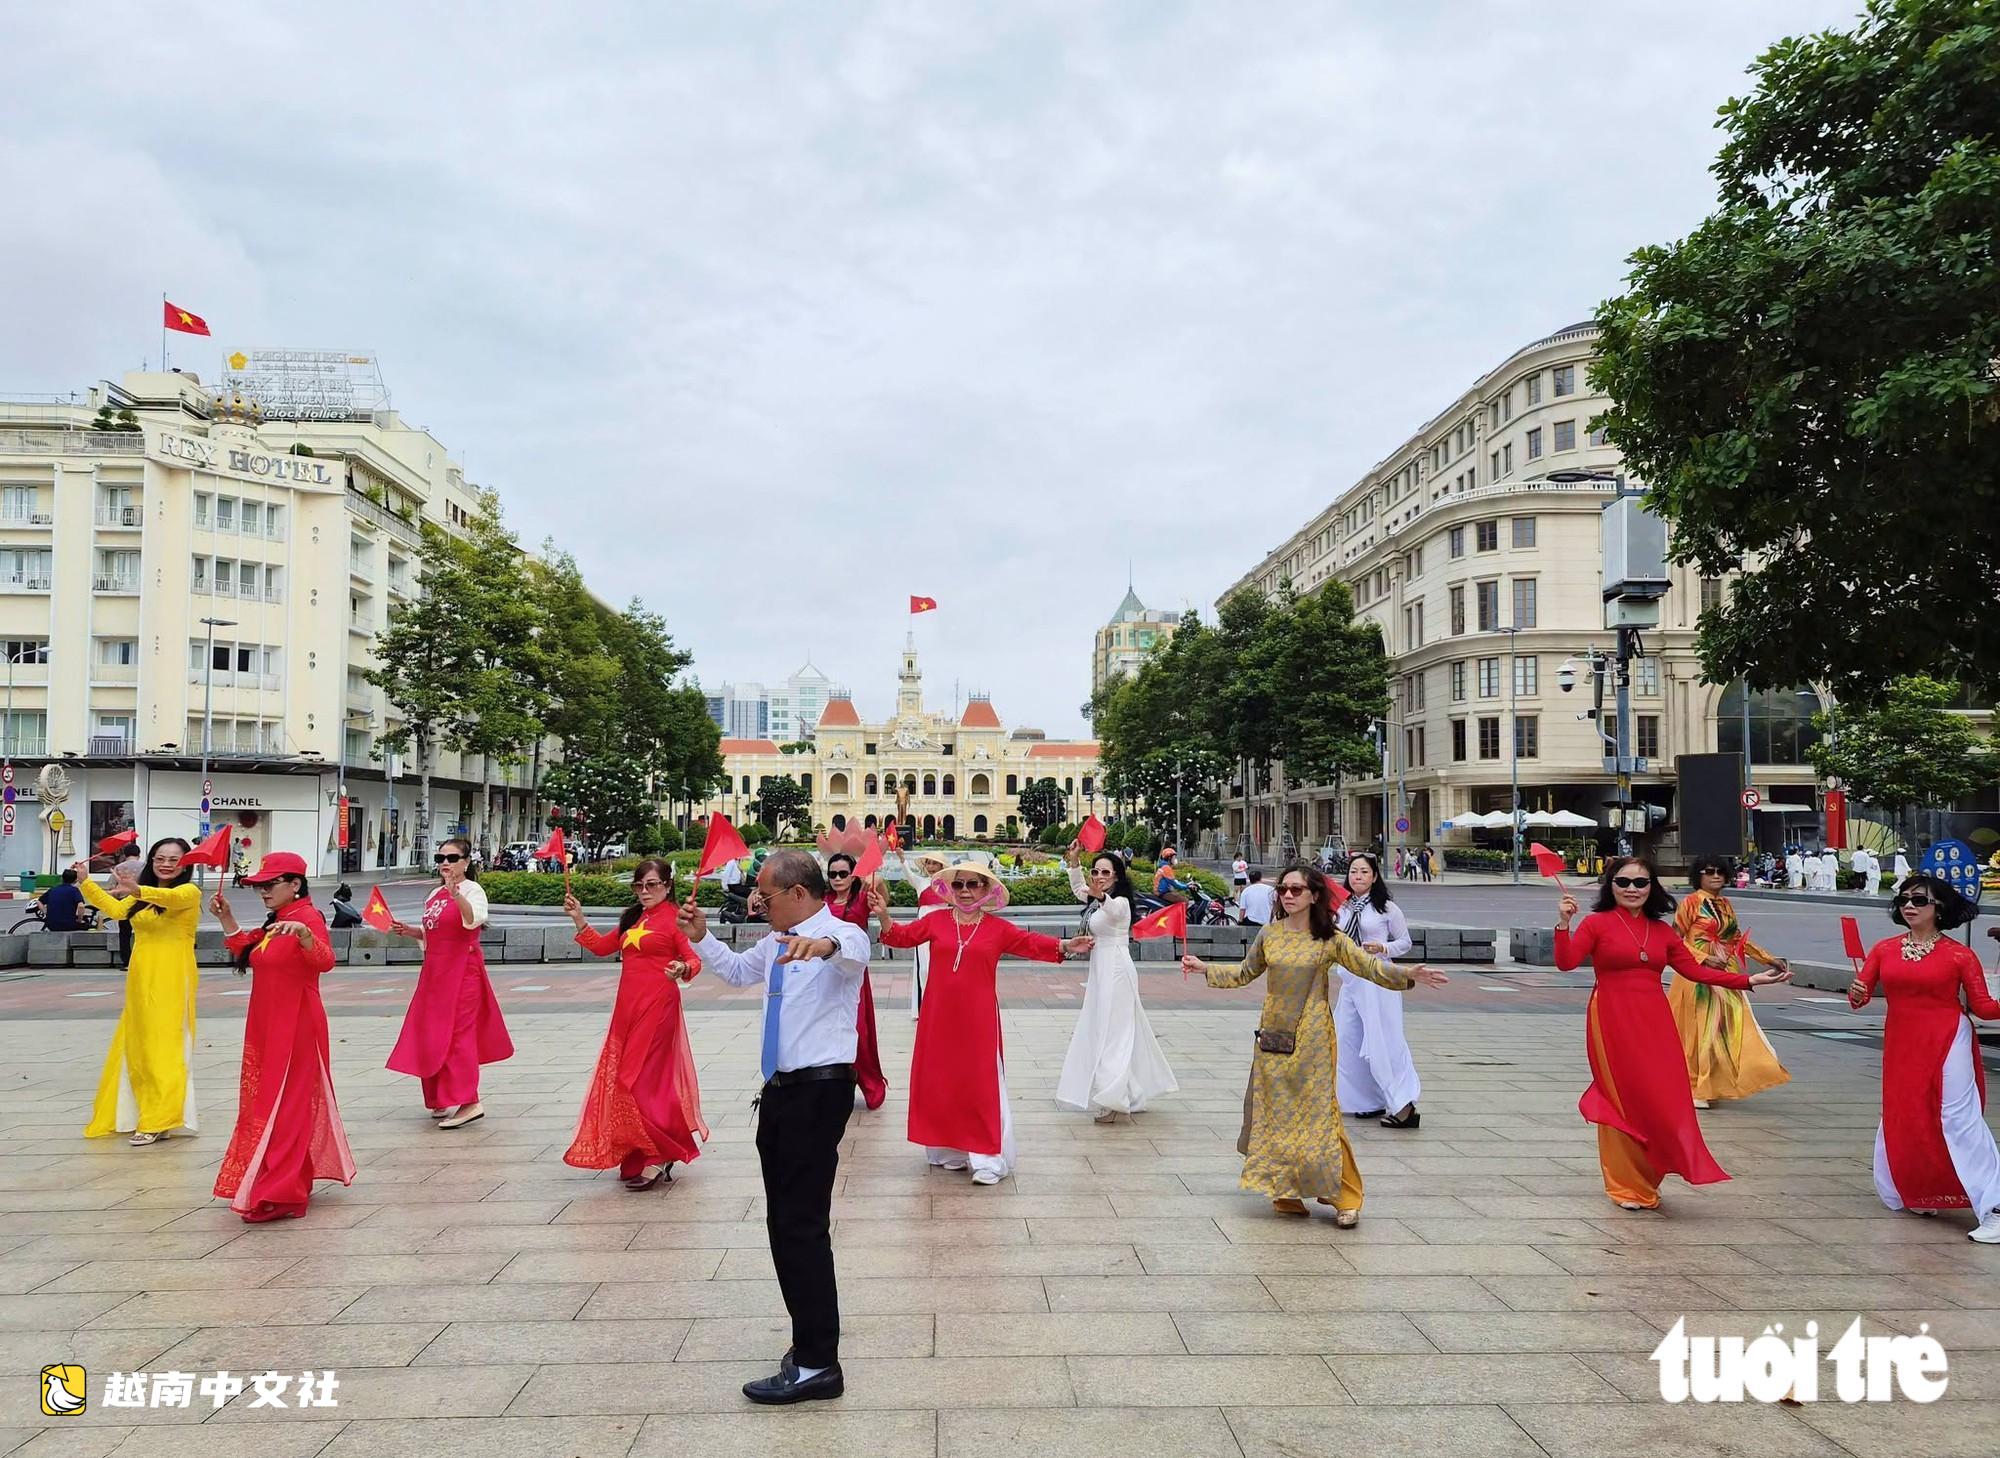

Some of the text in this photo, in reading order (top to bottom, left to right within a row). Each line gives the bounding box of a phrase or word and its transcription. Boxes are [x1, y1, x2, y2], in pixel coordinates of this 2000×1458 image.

[160, 432, 332, 485] REX HOTEL
[212, 797, 262, 807] CHANEL
